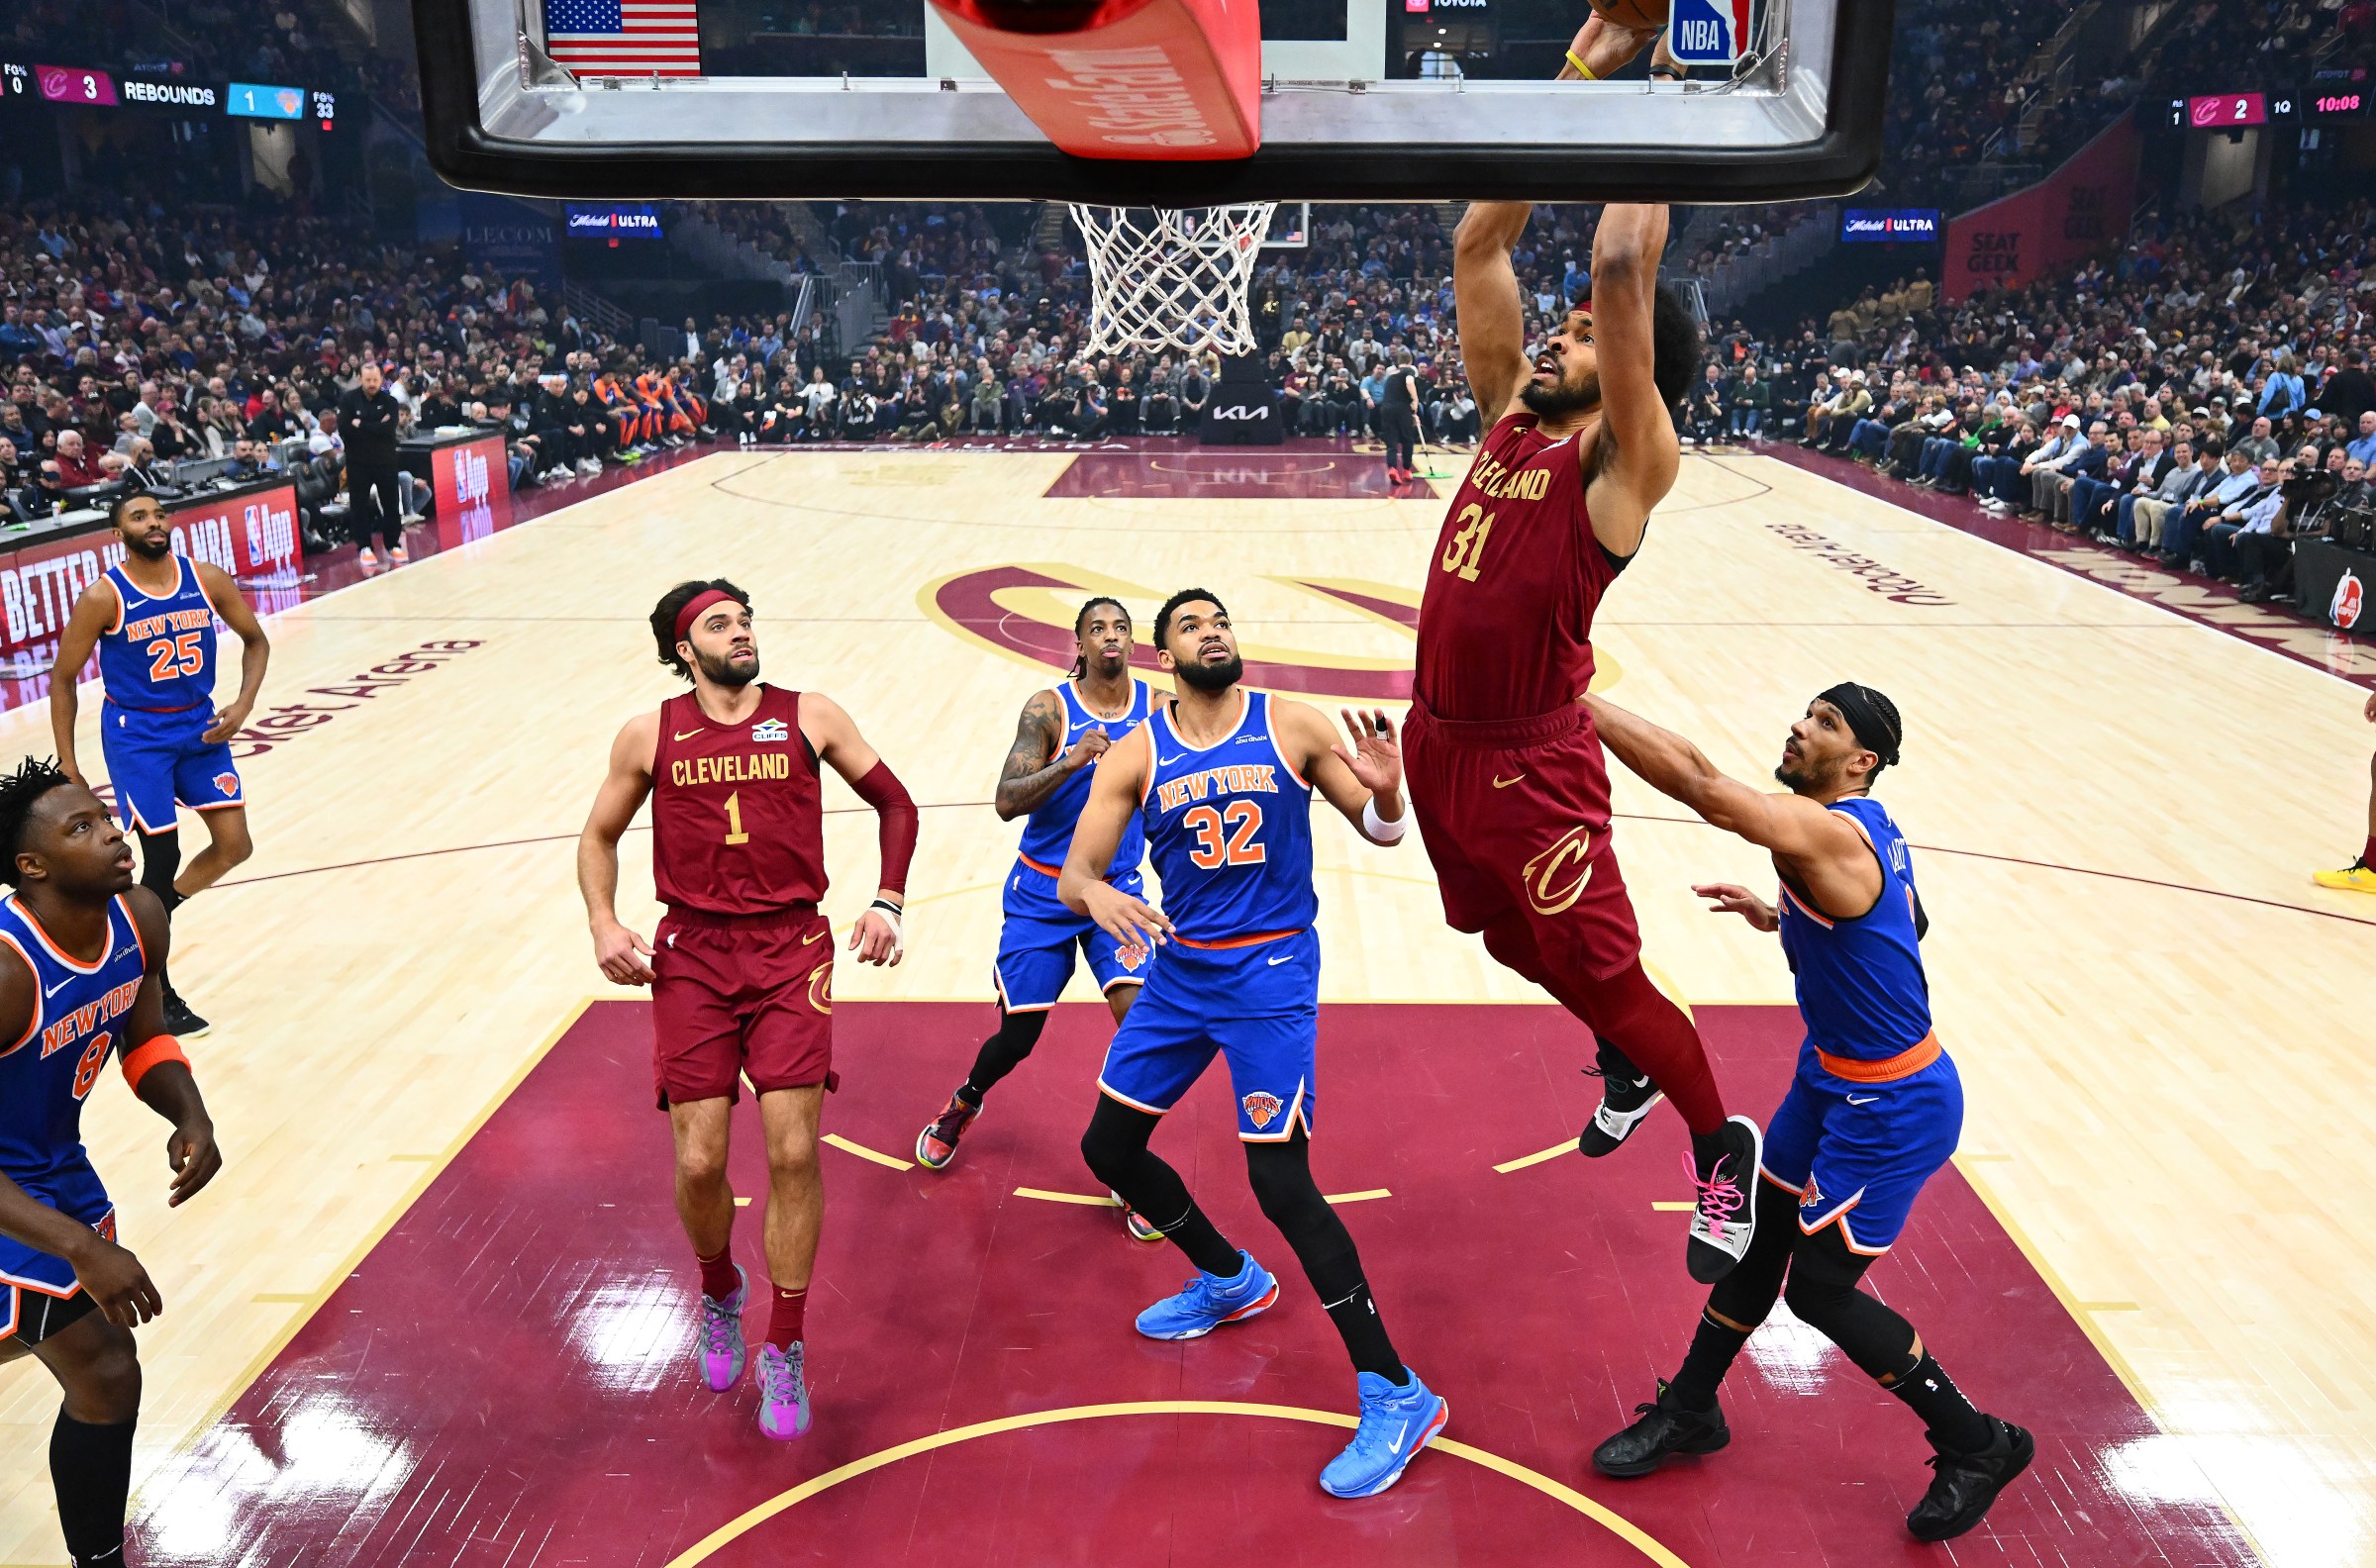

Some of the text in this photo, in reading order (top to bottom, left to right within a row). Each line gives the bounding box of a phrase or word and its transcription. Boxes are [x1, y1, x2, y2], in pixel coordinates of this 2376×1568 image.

[1681, 20, 1720, 50] NBA
[13, 77, 23, 94] 0
[83, 75, 98, 100] 3
[125, 81, 216, 106] REBOUNDS
[245, 90, 255, 112] 1
[316, 102, 335, 119] 33
[2234, 99, 2248, 120] 2
[2274, 100, 2292, 114] 1Q
[2317, 94, 2361, 113] 10:08
[2173, 112, 2180, 126] 1
[618, 215, 658, 228] ULTRA
[1893, 219, 1934, 232] ULTRA
[1971, 232, 2022, 252] SEAT
[1966, 253, 2021, 273] GEEK
[1213, 405, 1269, 421] KIA
[260, 504, 294, 572] App
[1442, 502, 1496, 583] 31
[125, 608, 211, 643] NEW YORK
[147, 631, 204, 683] 25
[306, 639, 486, 699] Arena
[1235, 736, 1248, 745] abu
[1248, 735, 1268, 743] dhabi
[671, 753, 789, 787] CLEVELAND
[1156, 764, 1279, 814] NEW YORK
[724, 790, 749, 845] 1
[1183, 799, 1266, 870] 32
[40, 1001, 100, 1061] NEW
[72, 1030, 113, 1102] 8
[1245, 1096, 1279, 1113] KNICKS
